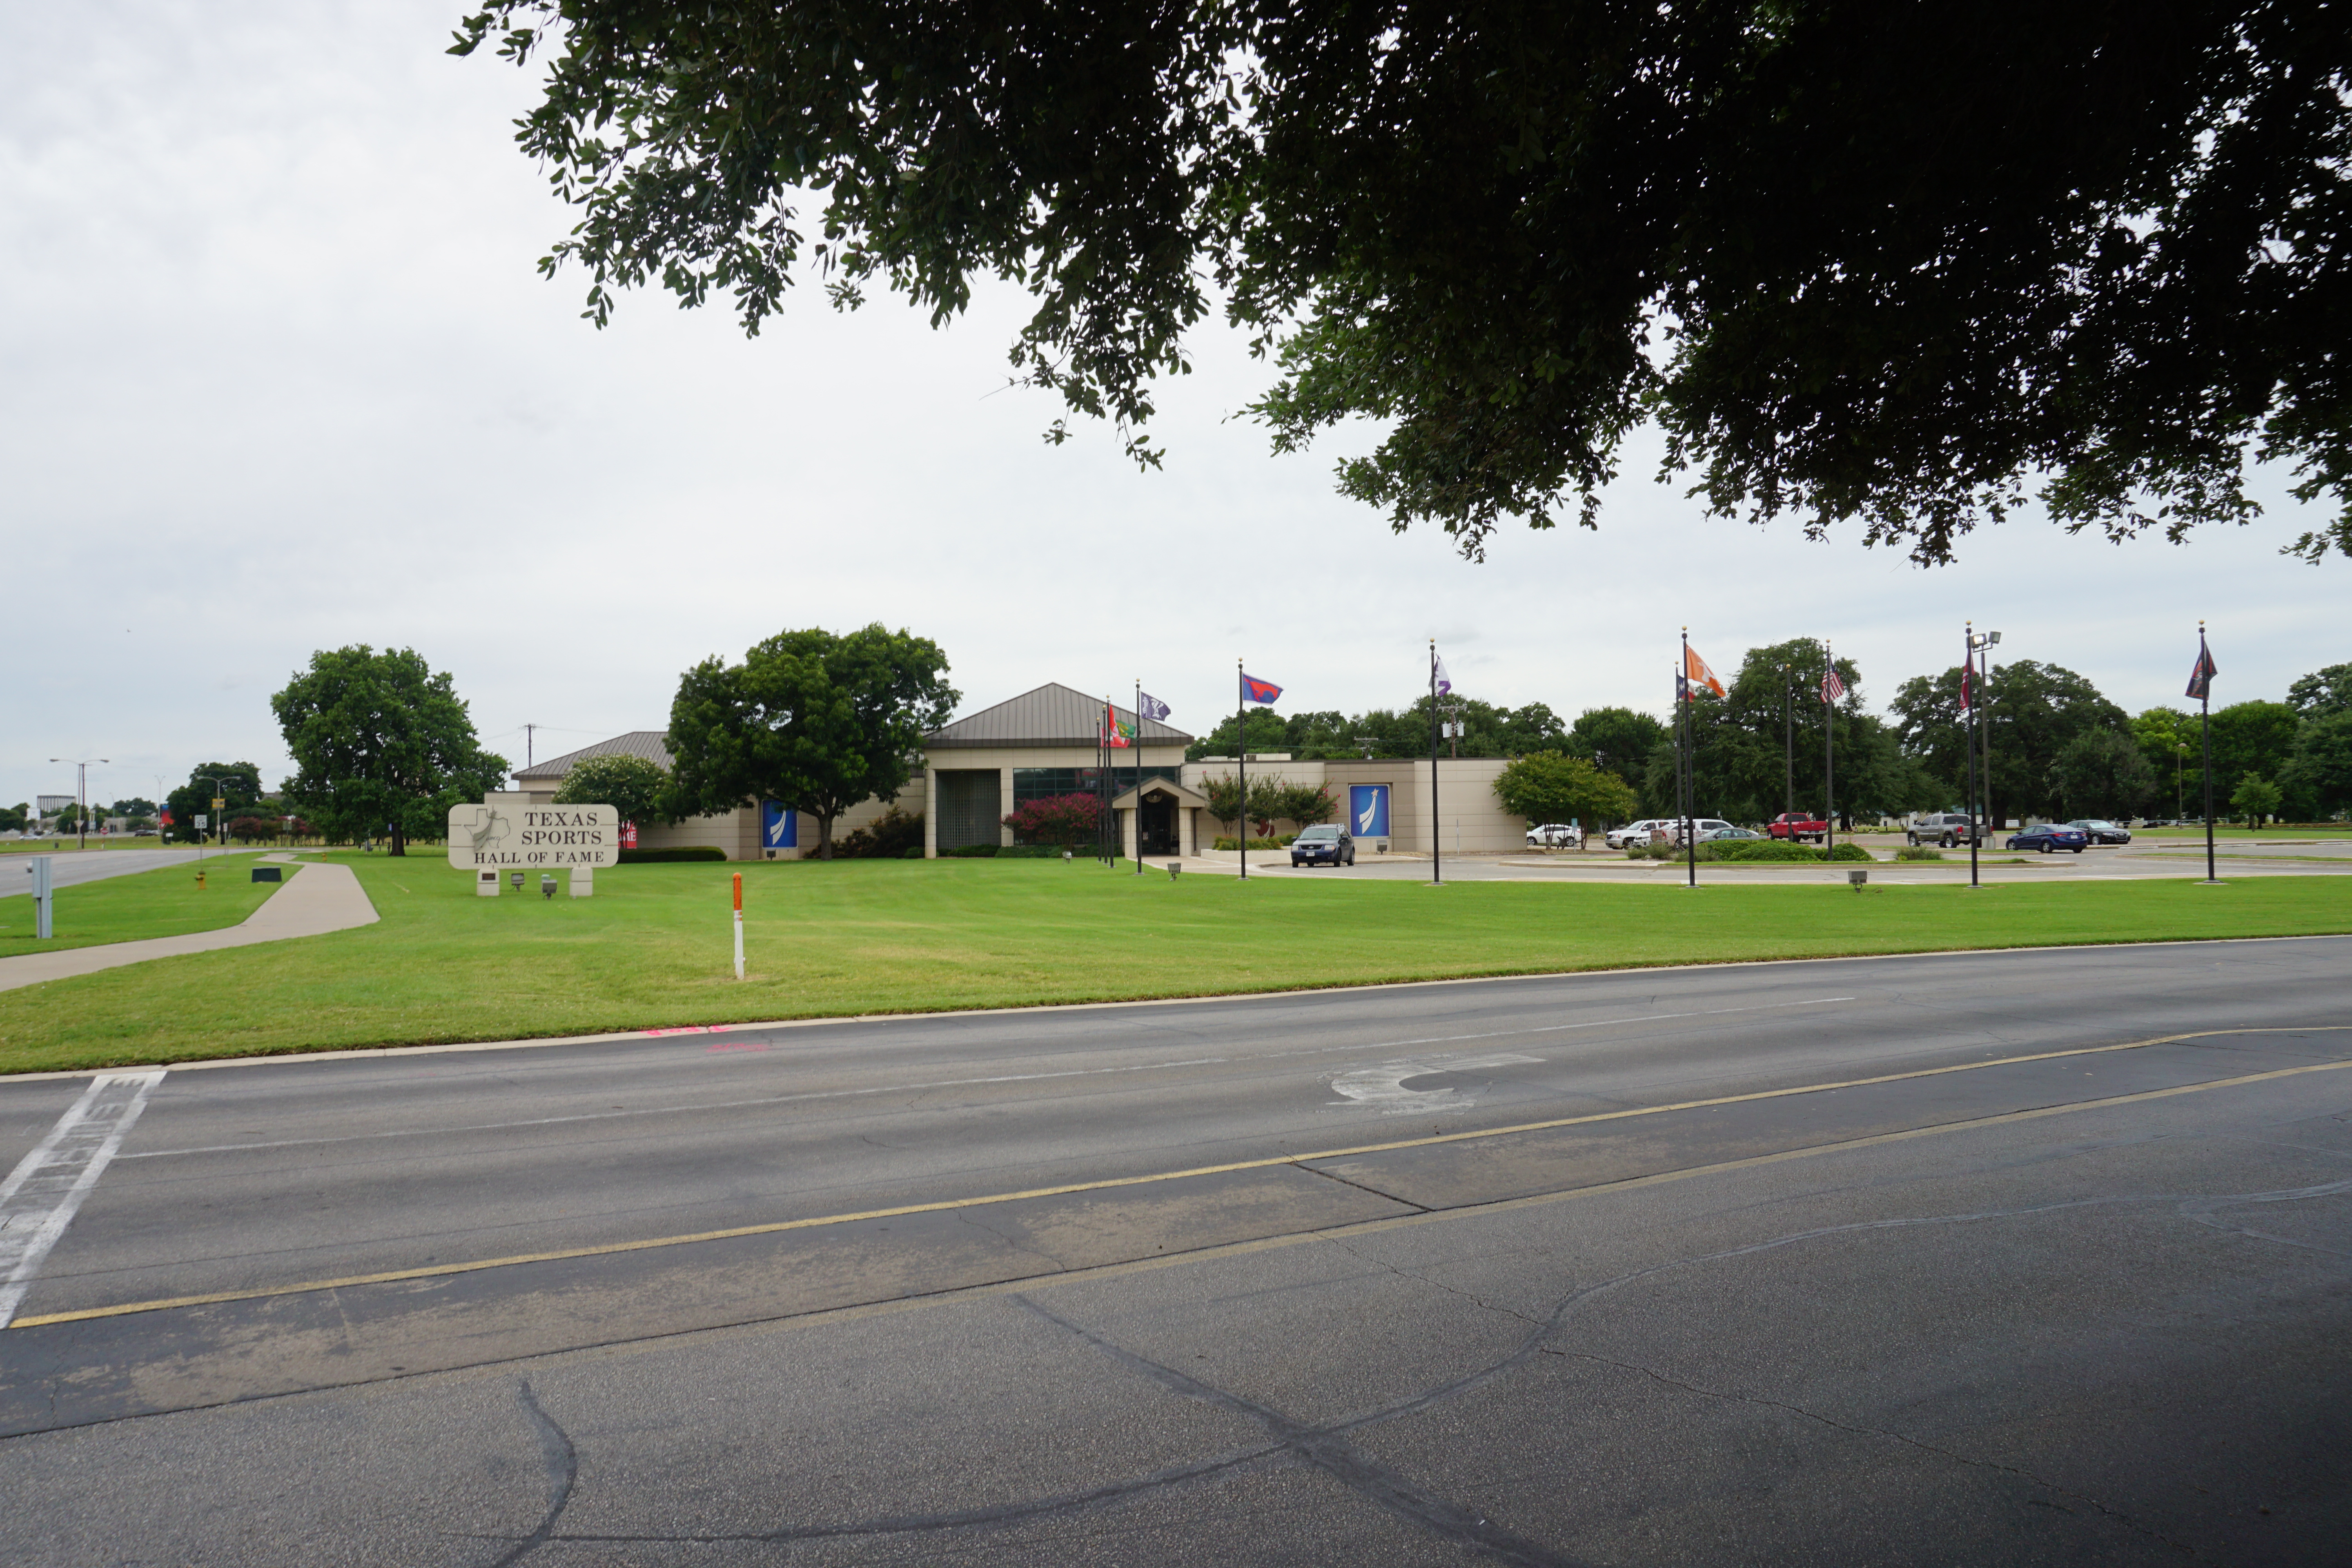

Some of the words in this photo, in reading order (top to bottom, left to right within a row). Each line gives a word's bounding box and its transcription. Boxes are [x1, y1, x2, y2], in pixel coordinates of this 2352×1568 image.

[525, 812, 597, 826] TEXAS
[522, 830, 602, 845] SPORTS
[474, 852, 521, 863] HALL
[528, 851, 548, 862] OF
[555, 851, 604, 862] FAME
